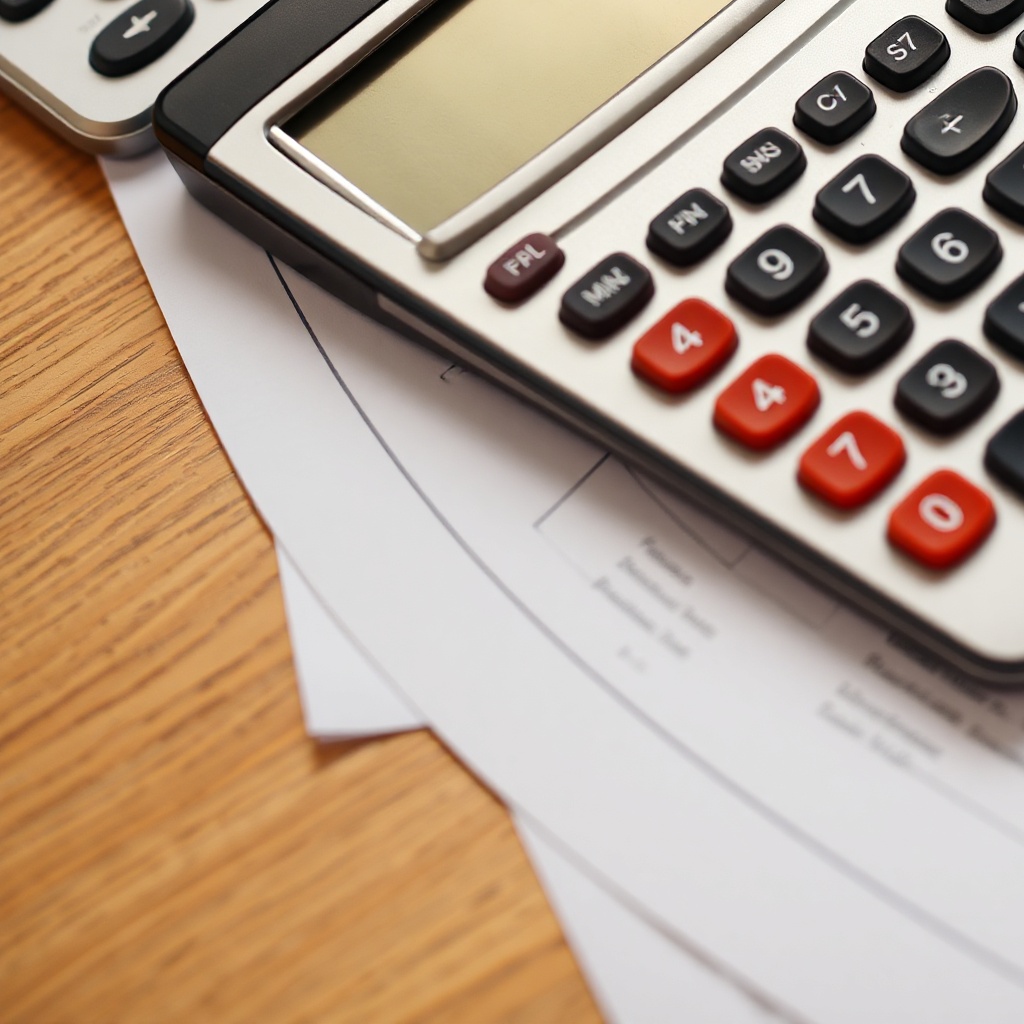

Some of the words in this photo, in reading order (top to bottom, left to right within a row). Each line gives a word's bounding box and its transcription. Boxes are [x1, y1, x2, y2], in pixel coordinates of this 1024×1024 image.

[841, 173, 877, 205] 7
[756, 247, 795, 281] 9
[930, 231, 970, 265] 6
[838, 302, 881, 339] 5
[670, 321, 704, 356] 4
[751, 377, 788, 413] 4
[825, 430, 868, 472] 7
[917, 492, 966, 533] 0
